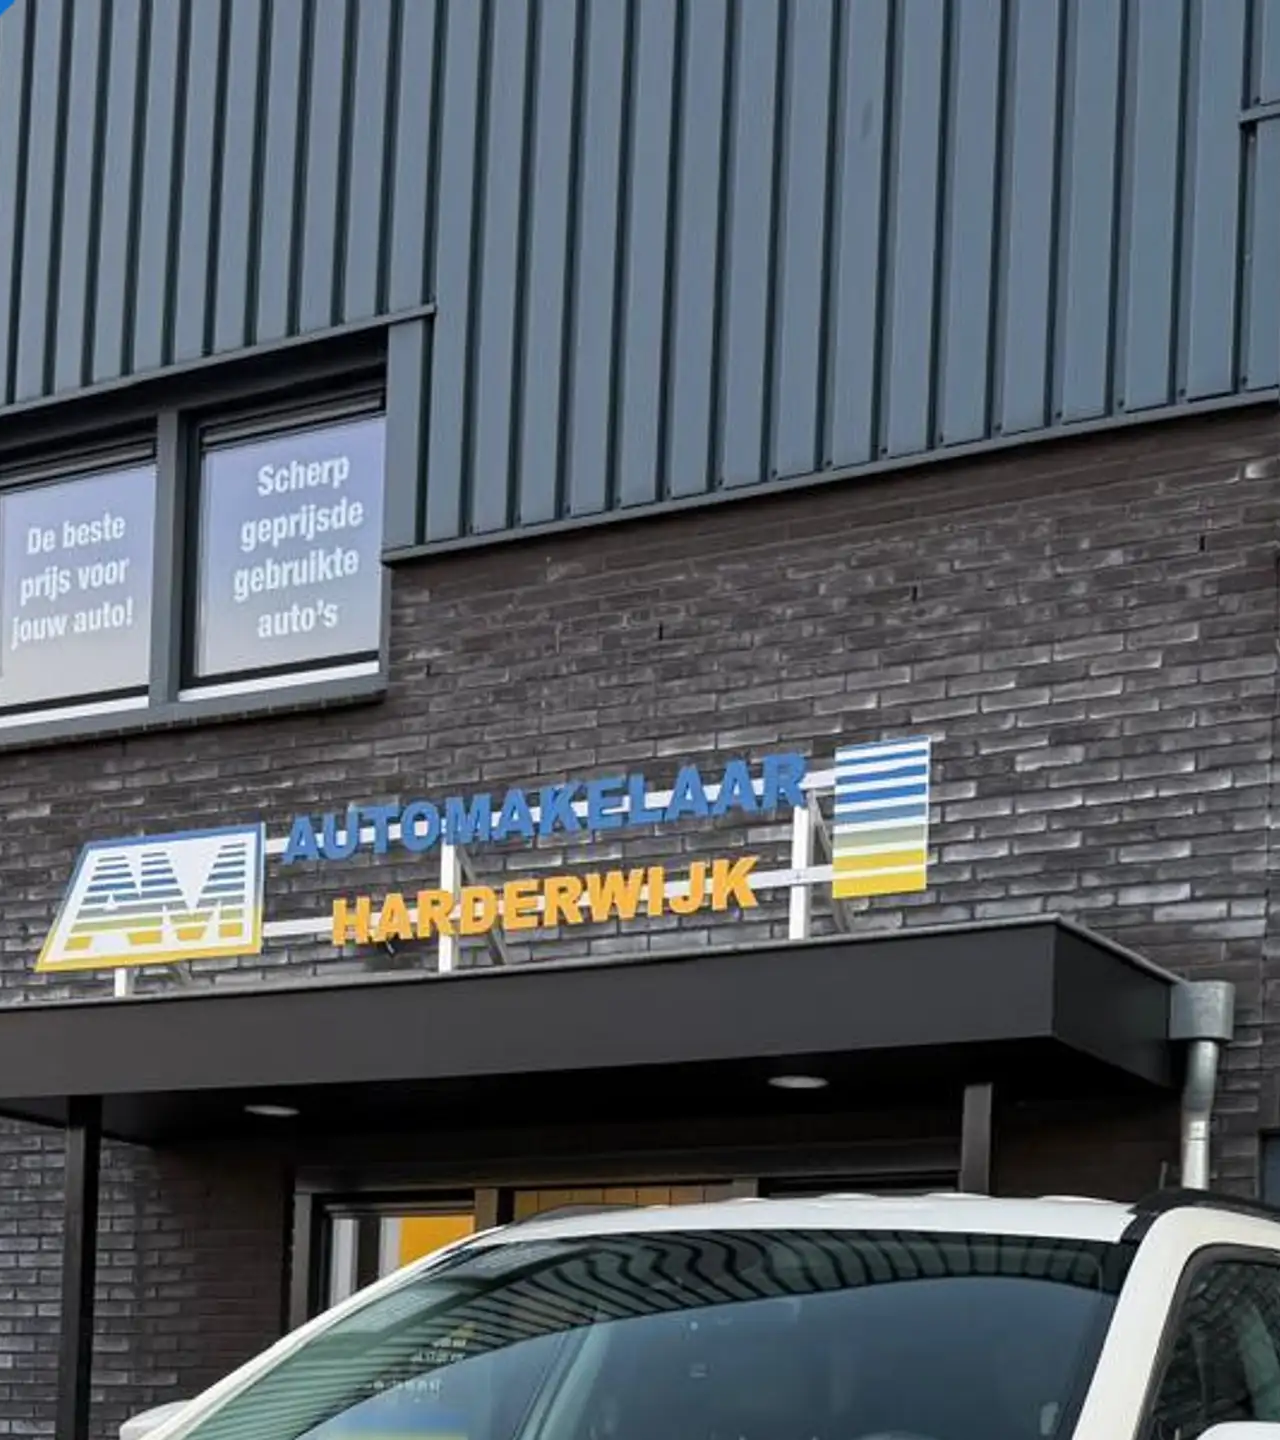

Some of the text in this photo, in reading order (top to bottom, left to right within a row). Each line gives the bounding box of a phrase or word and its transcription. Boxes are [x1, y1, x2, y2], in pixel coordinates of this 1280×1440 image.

[257, 454, 350, 496] Scherp
[27, 513, 126, 555] De beste
[240, 498, 363, 552] geprijsde
[20, 559, 129, 607] prijs voor
[233, 548, 359, 601] gebruikte
[11, 598, 134, 651] jouw auto!
[257, 601, 339, 638] auto's
[282, 752, 806, 864] AUTOMAKELAAR
[331, 855, 760, 946] HARDERWIJK
